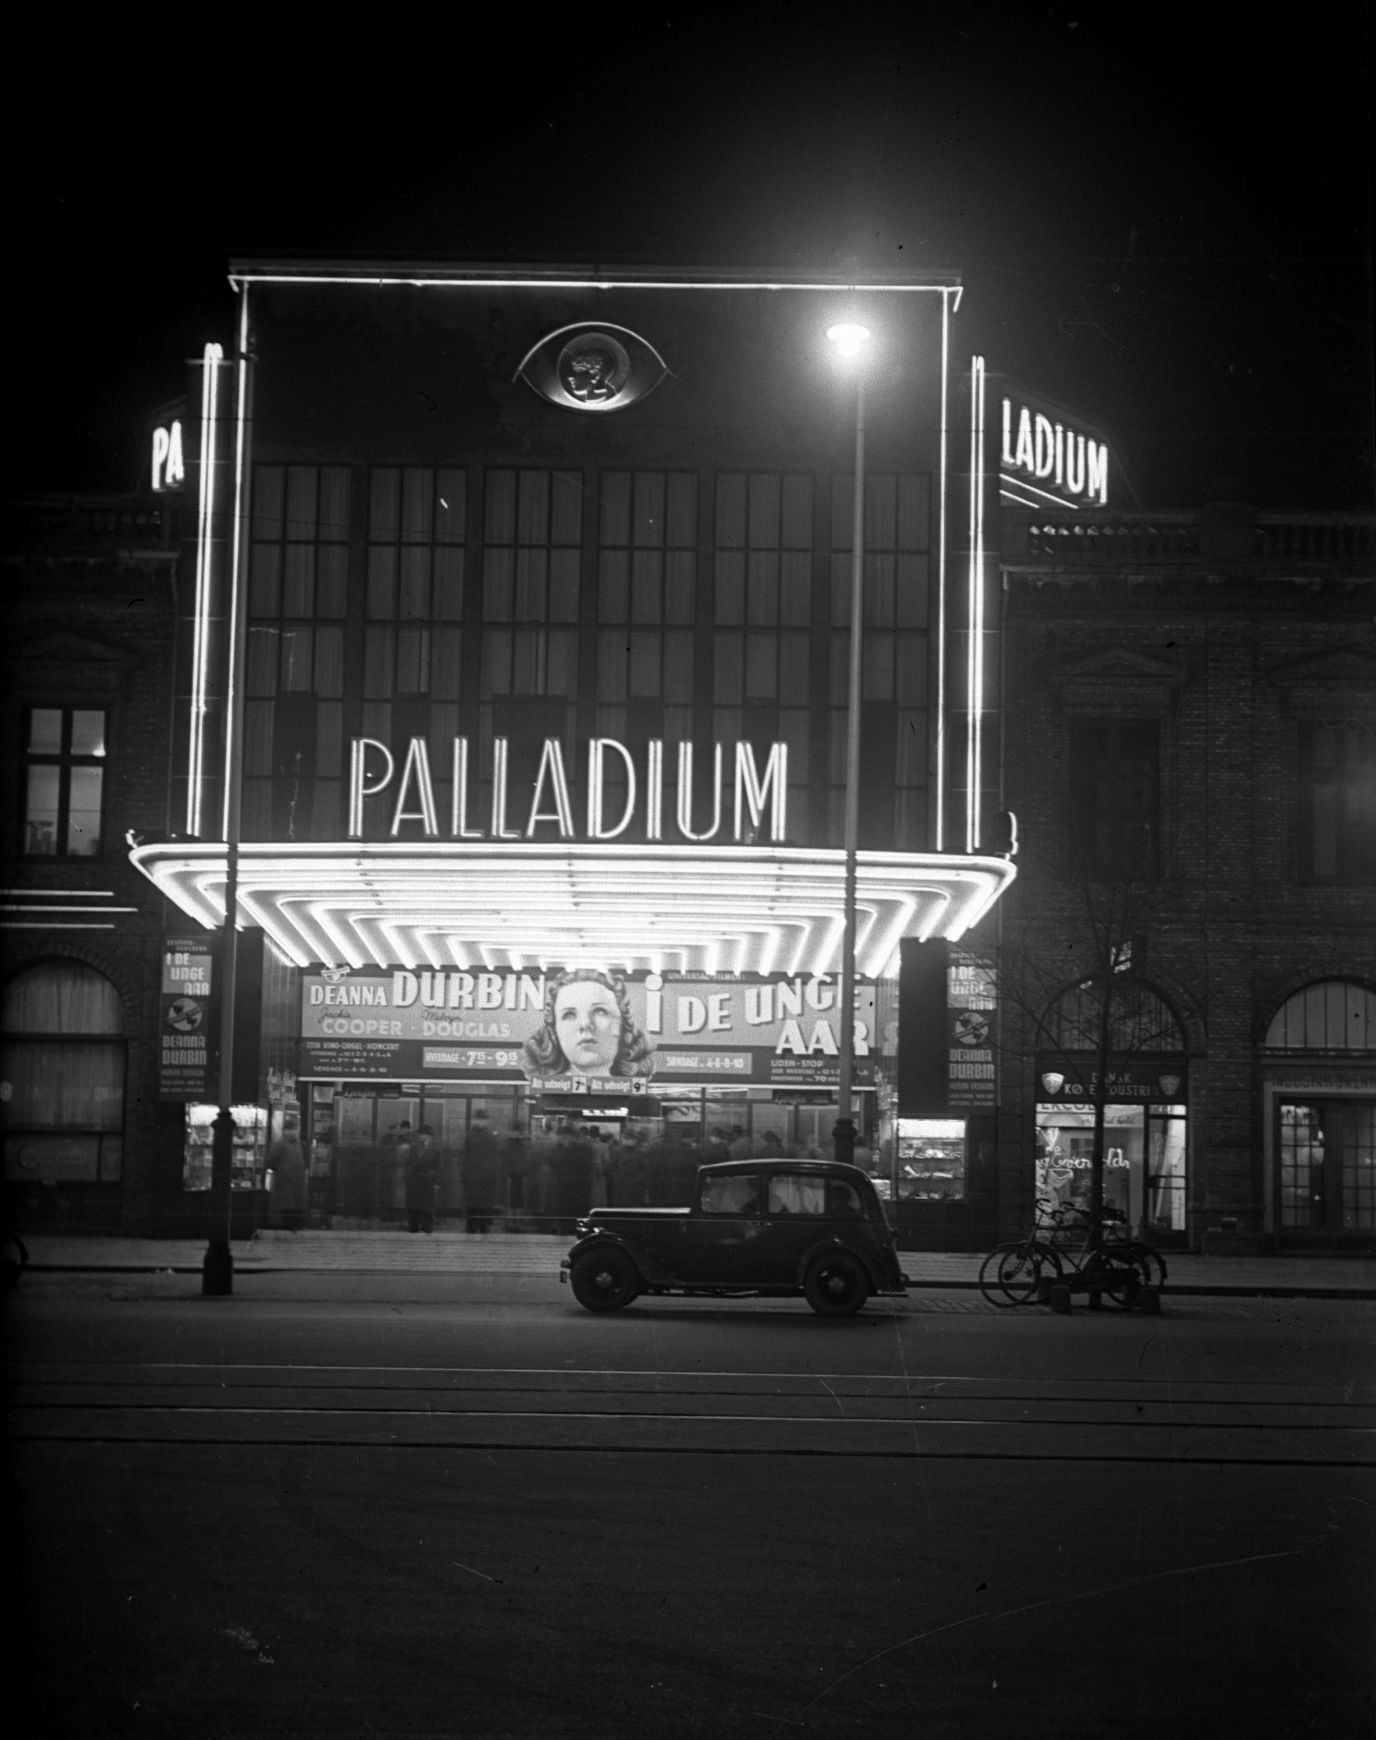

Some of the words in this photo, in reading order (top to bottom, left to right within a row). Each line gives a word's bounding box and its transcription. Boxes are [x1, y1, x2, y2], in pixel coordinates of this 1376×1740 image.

[152, 420, 184, 491] PA
[1002, 398, 1108, 504] LADIUM
[348, 736, 790, 844] PALLADIUM
[166, 952, 172, 965] I
[174, 952, 190, 965] DE
[170, 967, 205, 980] UNGE
[951, 966, 956, 979] I
[959, 966, 976, 980] DE
[184, 982, 209, 996] AAR
[310, 985, 387, 1006] DEANNA
[392, 970, 546, 1011] DURBIN
[677, 992, 732, 1034] DE
[322, 1018, 403, 1036] COOPER
[423, 1021, 511, 1038] DOUGLAS
[162, 1034, 206, 1048] DEANNA
[775, 1018, 870, 1056] AAR
[162, 1049, 207, 1065] DURBIN
[949, 1048, 993, 1062] DEANNA
[949, 1063, 995, 1079] DURBIN
[1091, 1072, 1132, 1083] DNSK
[1064, 1083, 1150, 1096] KØEDUSTRI
